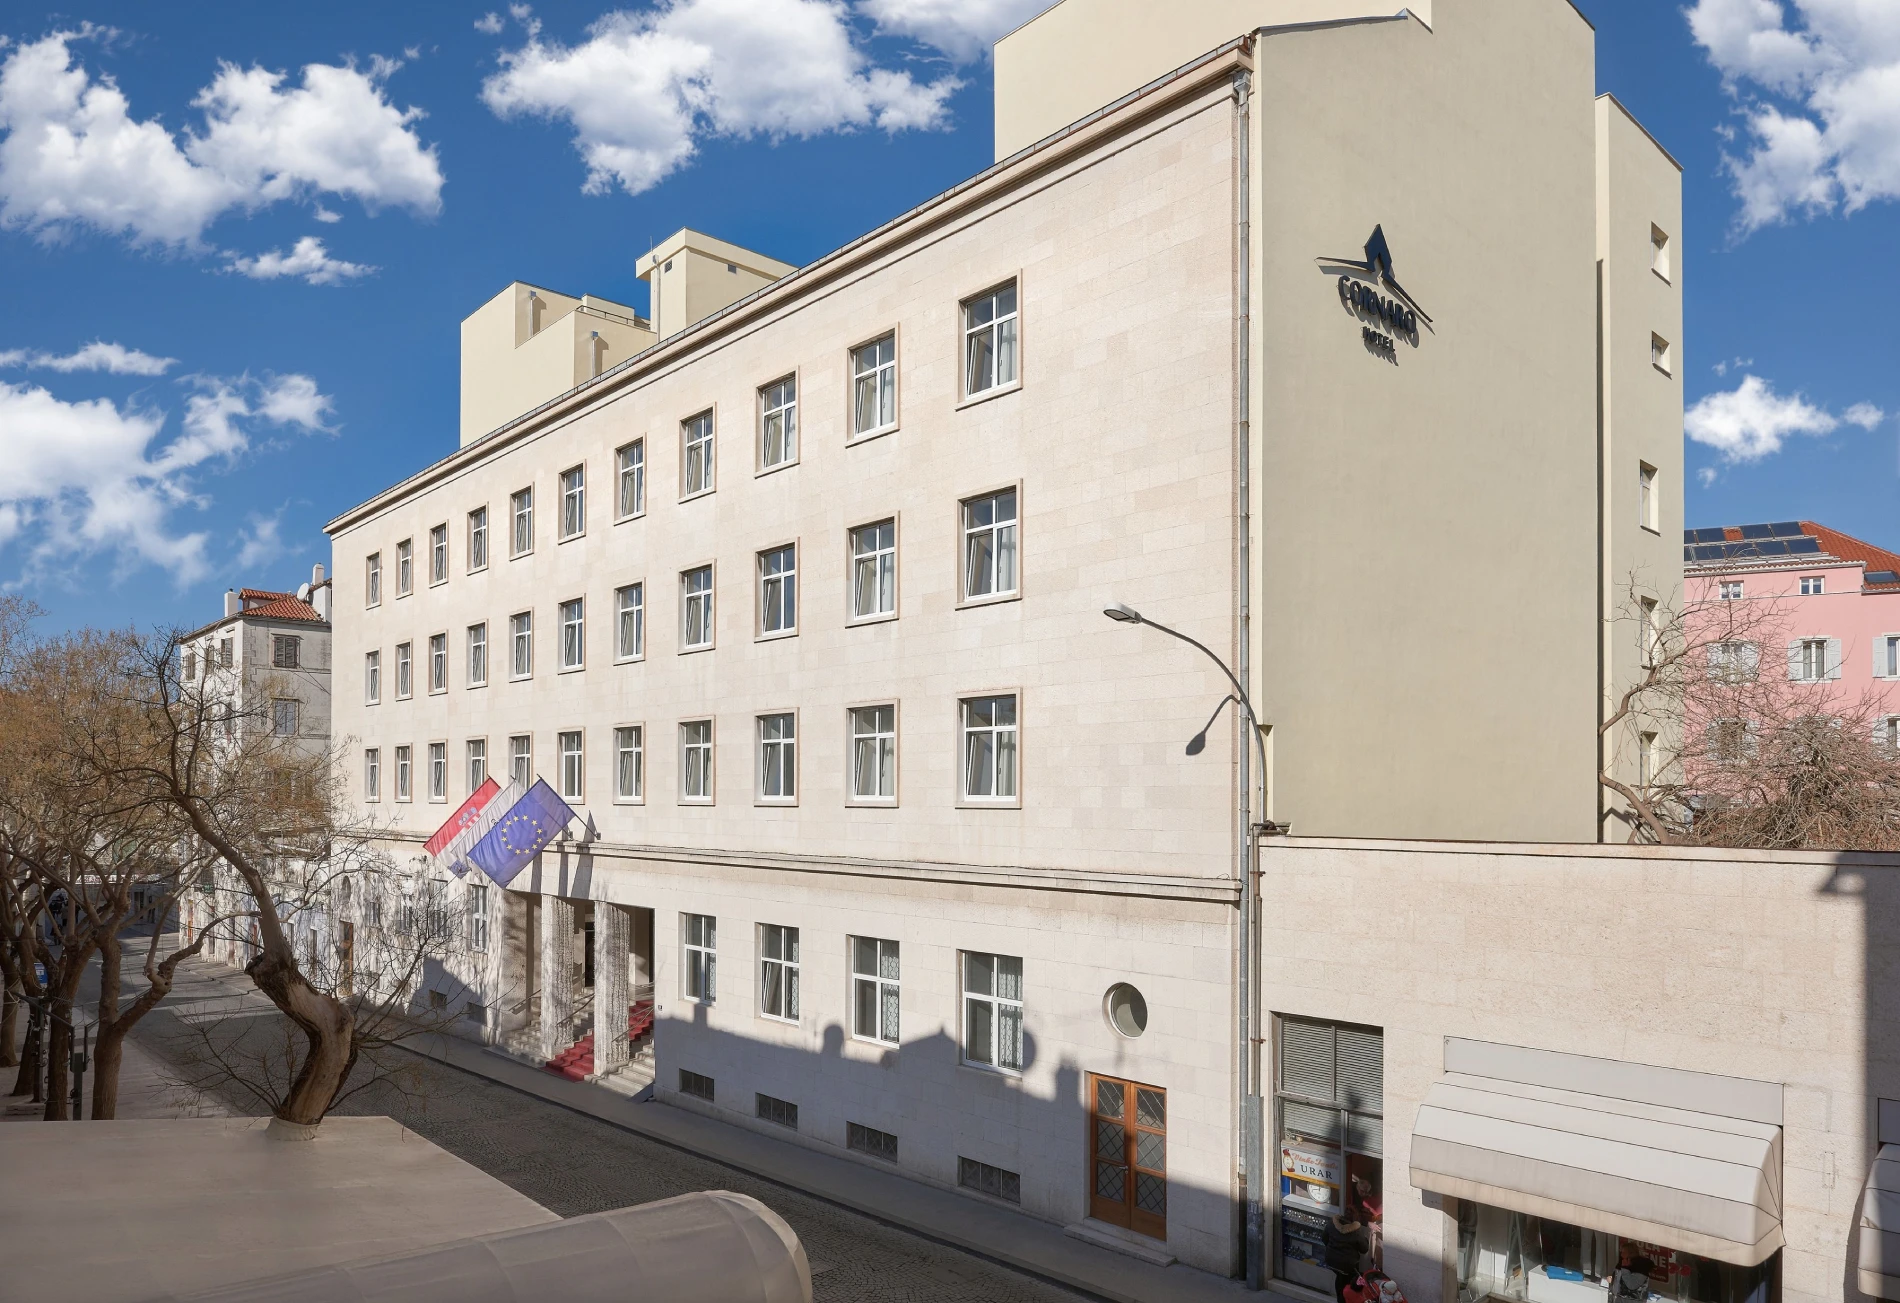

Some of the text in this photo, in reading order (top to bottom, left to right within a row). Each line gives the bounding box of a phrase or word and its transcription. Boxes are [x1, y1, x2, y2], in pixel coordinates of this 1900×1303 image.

[1338, 275, 1416, 334] CORNARO
[1362, 326, 1395, 353] HOTEL
[1300, 1164, 1333, 1180] URAR
